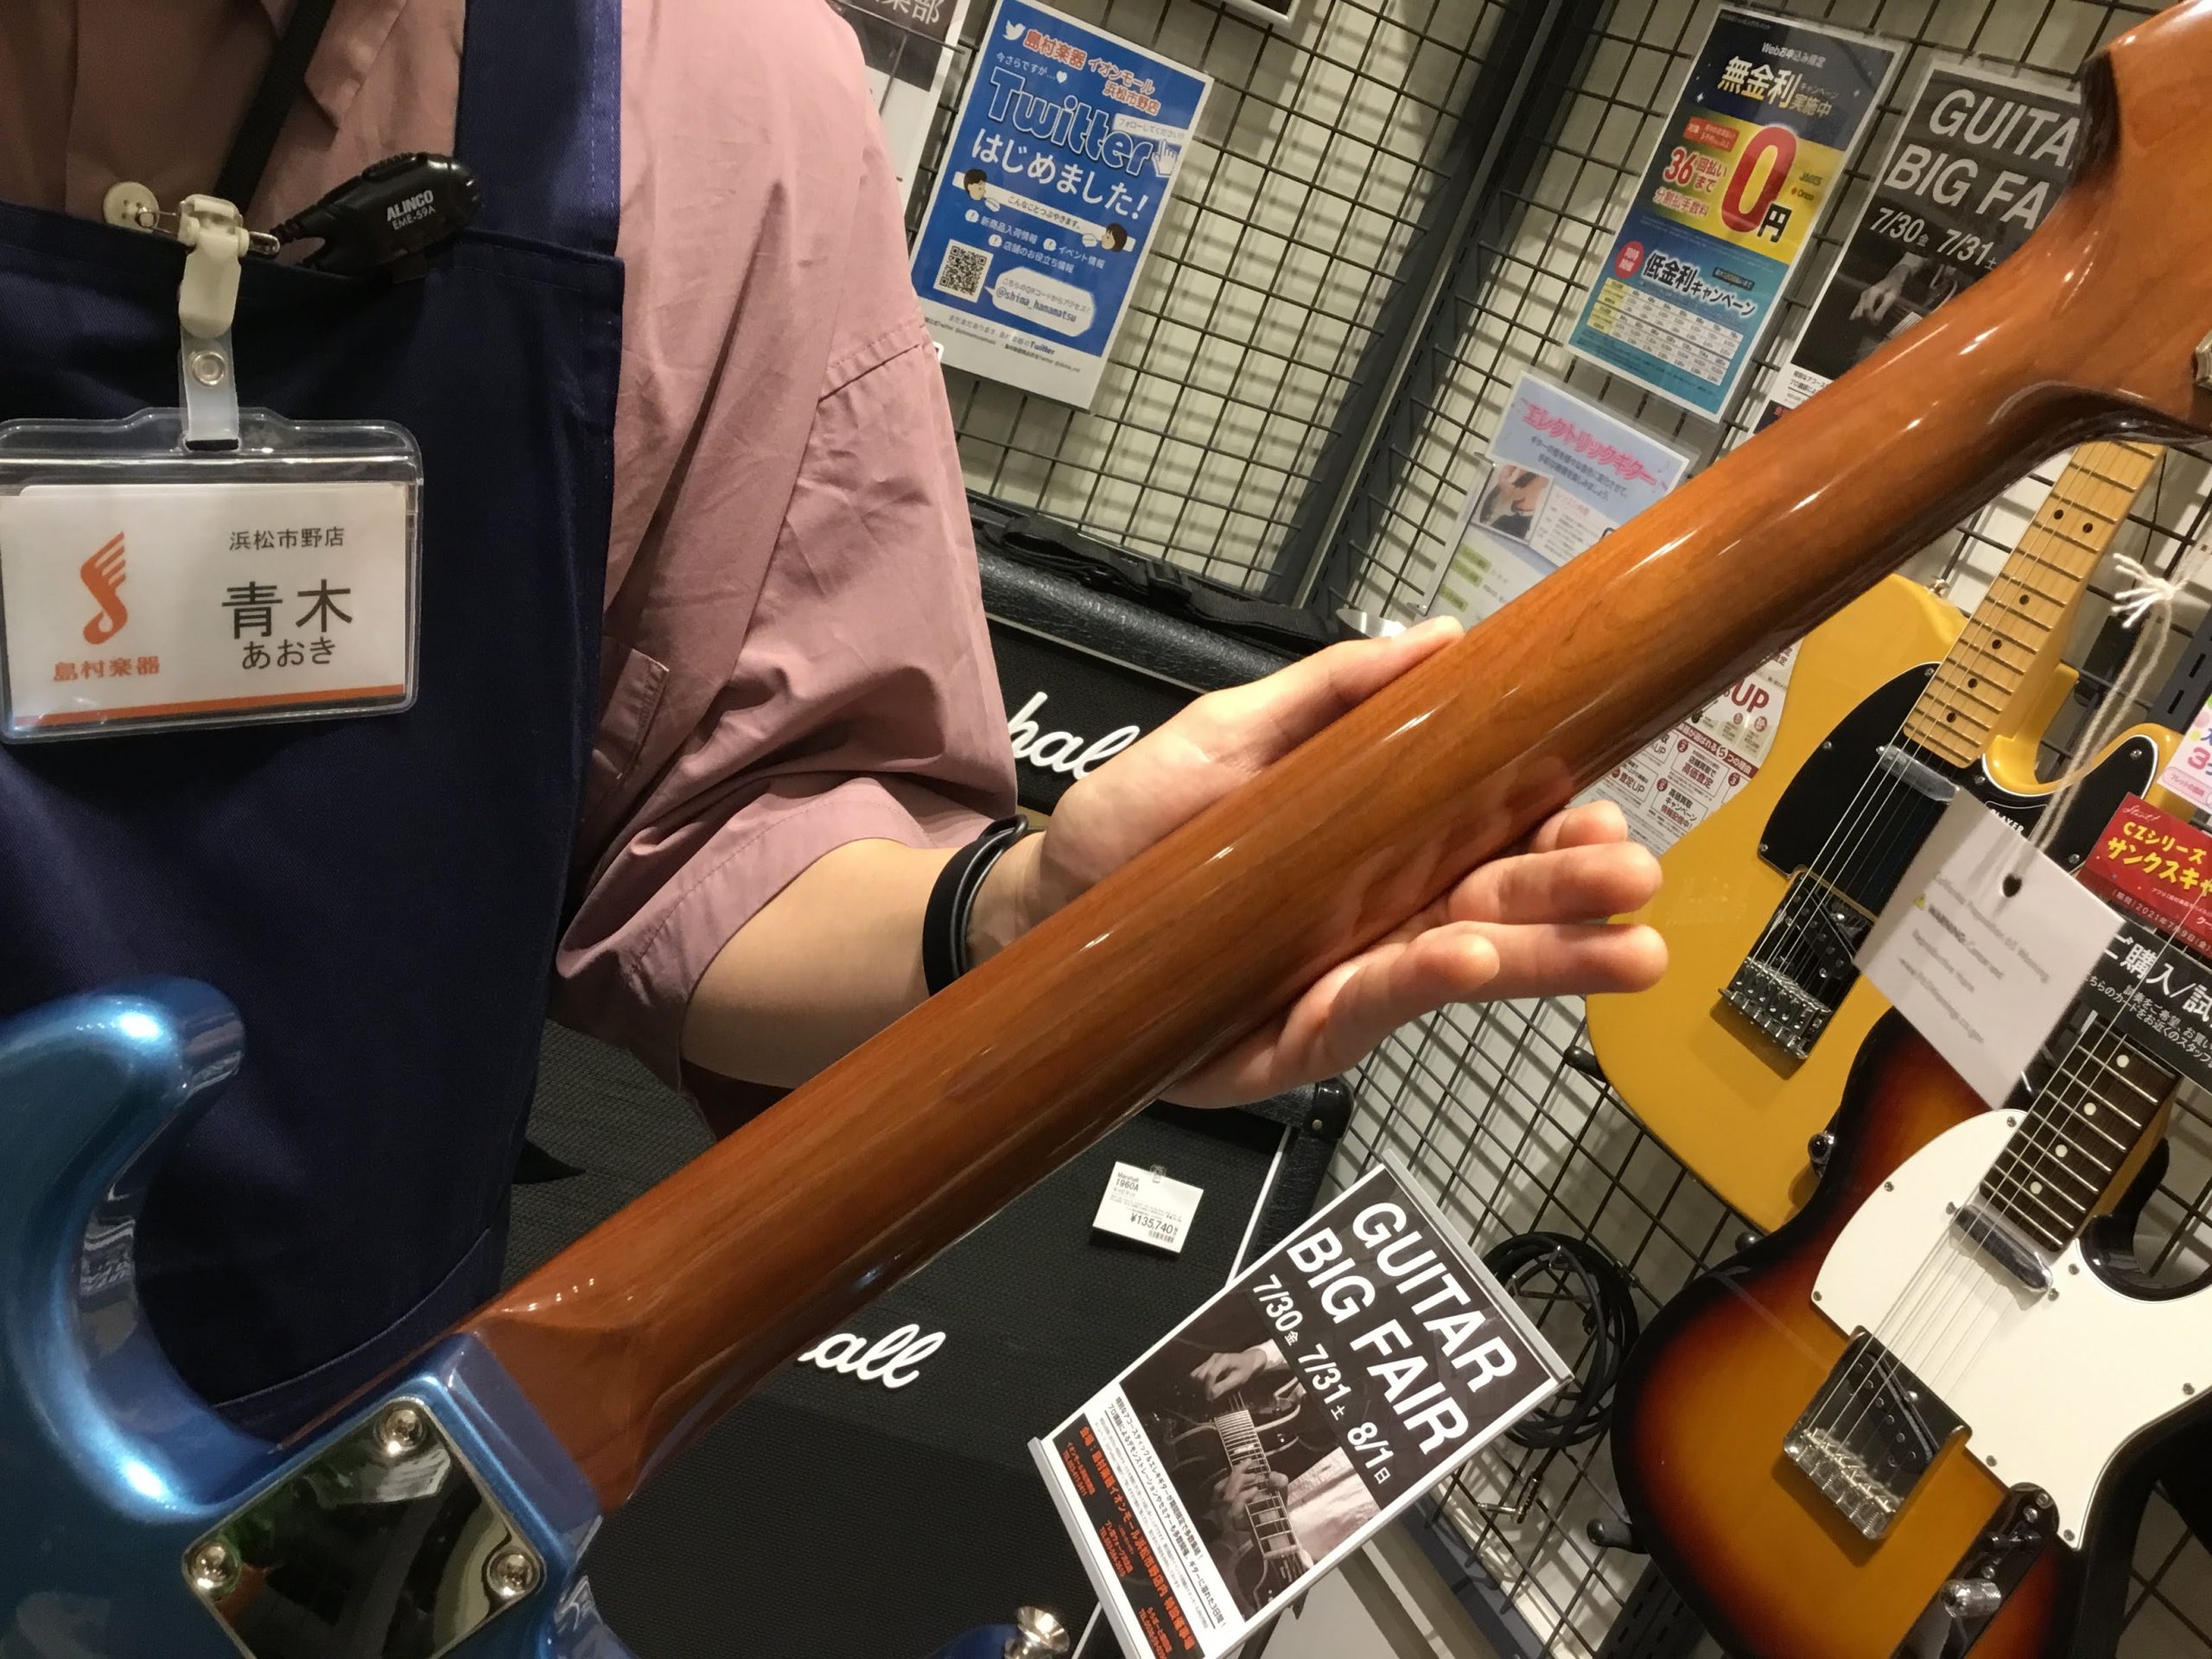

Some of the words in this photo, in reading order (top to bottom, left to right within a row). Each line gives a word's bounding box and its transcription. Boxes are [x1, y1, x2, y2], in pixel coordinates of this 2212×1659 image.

[1024, 29, 1087, 70] 島村楽器
[1089, 58, 1155, 95] イオンモール
[1103, 81, 1160, 116] 浜松市野店
[1718, 56, 1803, 108] 無金利
[988, 66, 1154, 176] Twitter
[1789, 93, 1833, 118] 実施中
[1929, 88, 2081, 170] GUITA
[1664, 147, 1697, 185] 36
[1885, 143, 1979, 207] BIG
[1694, 175, 1717, 193] まで
[386, 189, 435, 222] ALINCO
[980, 215, 1039, 245] 新商品入荷情報
[1058, 245, 1106, 270] イベント情報
[1522, 404, 1657, 486] エレクトリックギター
[229, 525, 345, 551] 浜松市野店
[221, 578, 354, 639] 青木
[53, 655, 162, 683] 島村楽器
[241, 636, 337, 671] あおき
[1665, 797, 1698, 822] キャンペーン
[2123, 821, 2207, 865] CZシリーズ
[1116, 1178, 1139, 1192] 1960A
[1130, 1212, 1173, 1235] ¥135,740
[1352, 1202, 1517, 1392] GUITAR
[1287, 1228, 1376, 1325] BIG
[1350, 1319, 1469, 1456] FAIR
